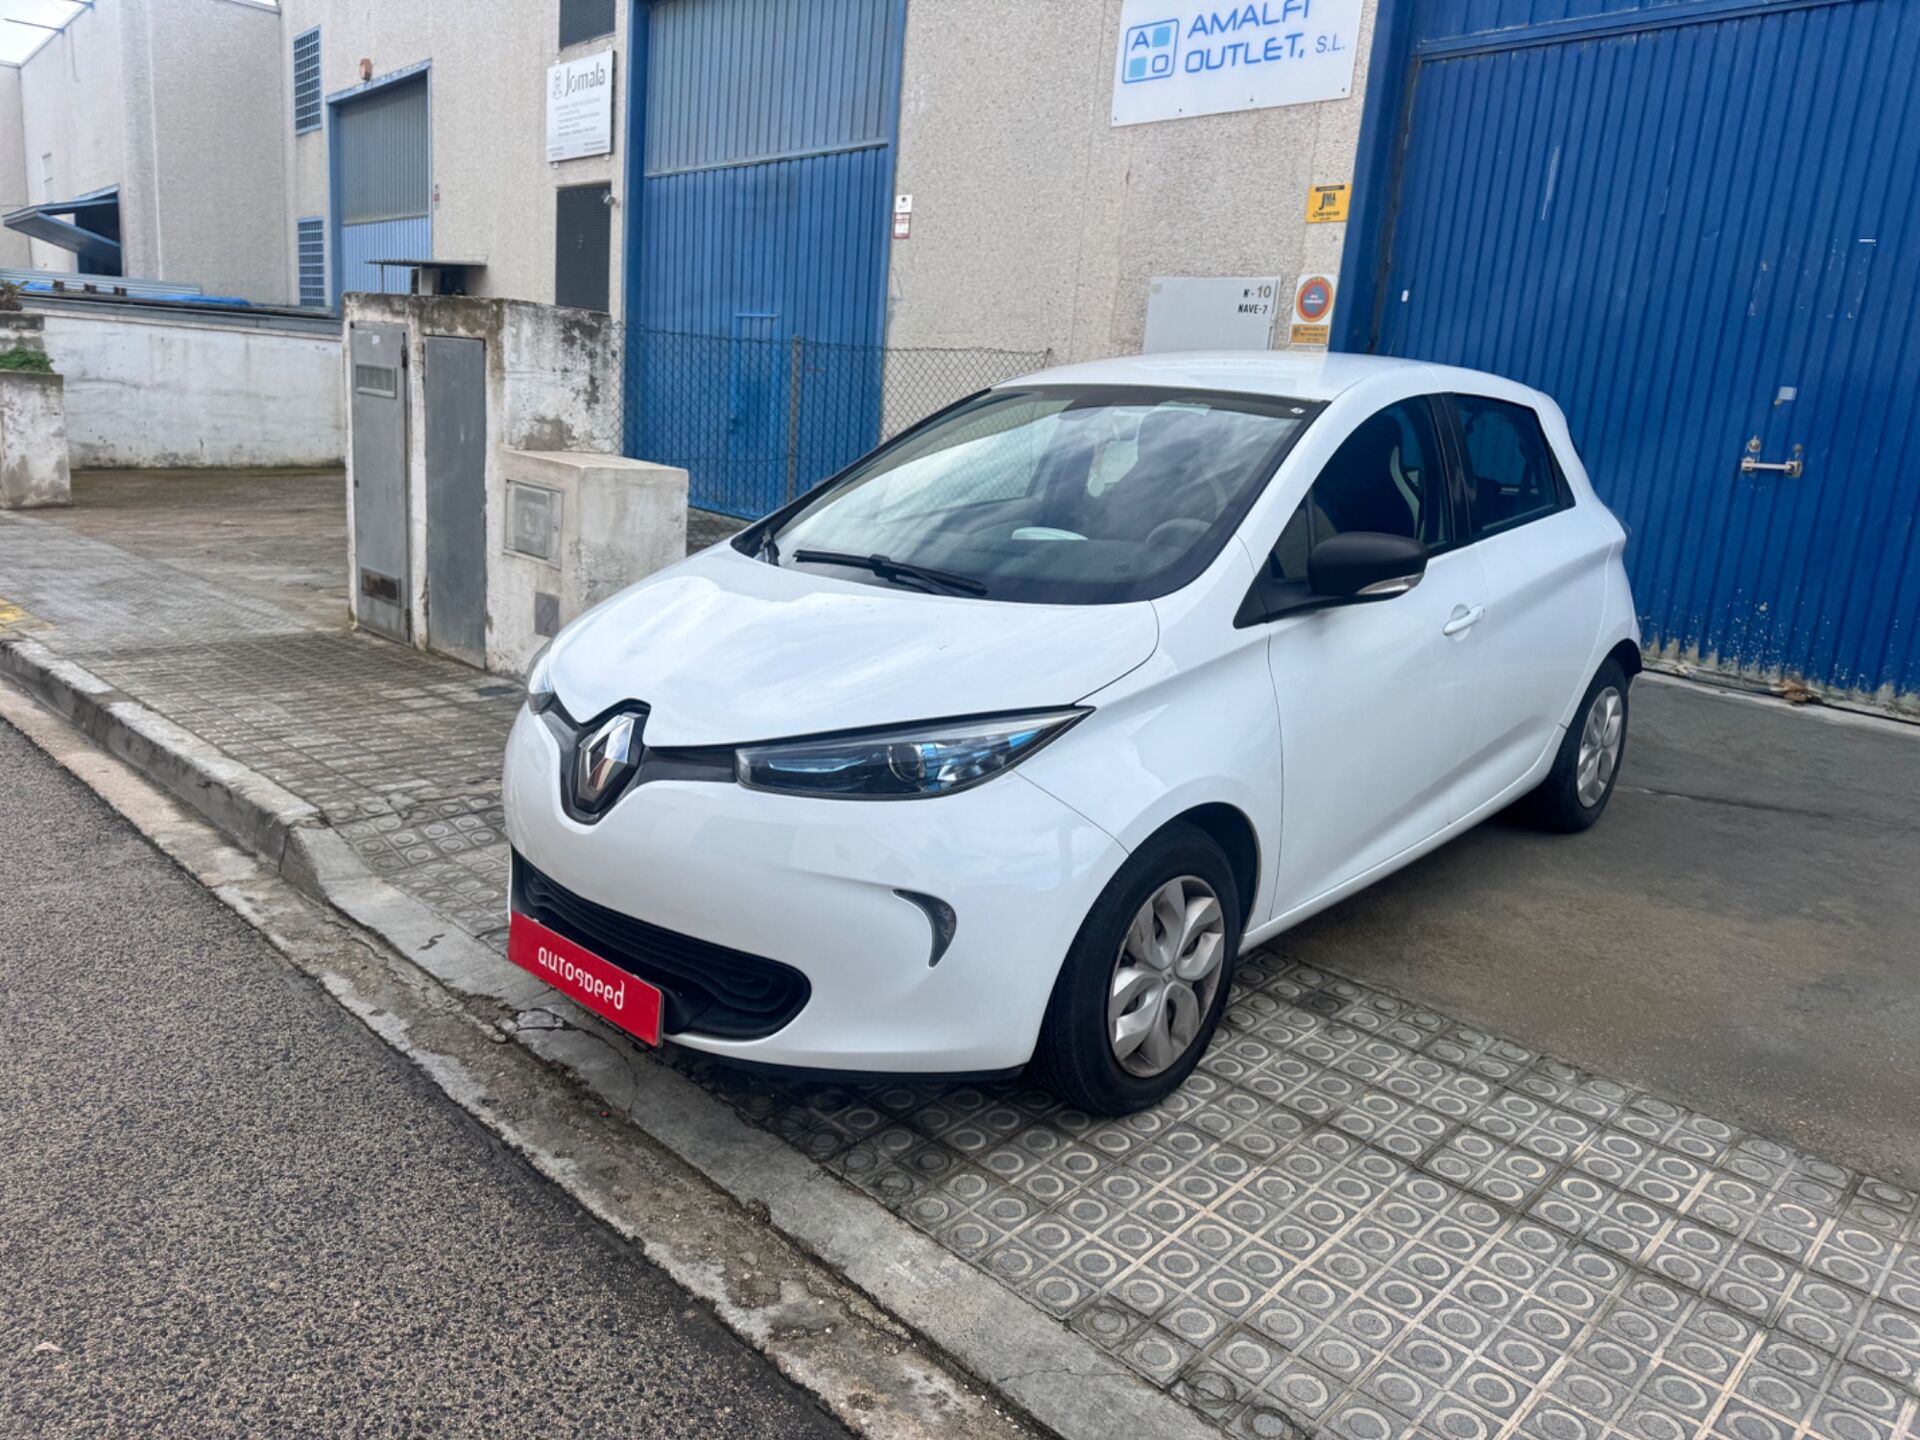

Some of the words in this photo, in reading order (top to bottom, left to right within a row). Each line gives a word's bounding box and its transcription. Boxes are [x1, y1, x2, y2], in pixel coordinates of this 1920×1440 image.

[1187, 0, 1310, 39] AMALFI
[1185, 33, 1304, 73] OUTLET,
[1315, 34, 1346, 54] S.L.
[564, 61, 606, 97] Jomala
[537, 946, 625, 1010] autospeed
